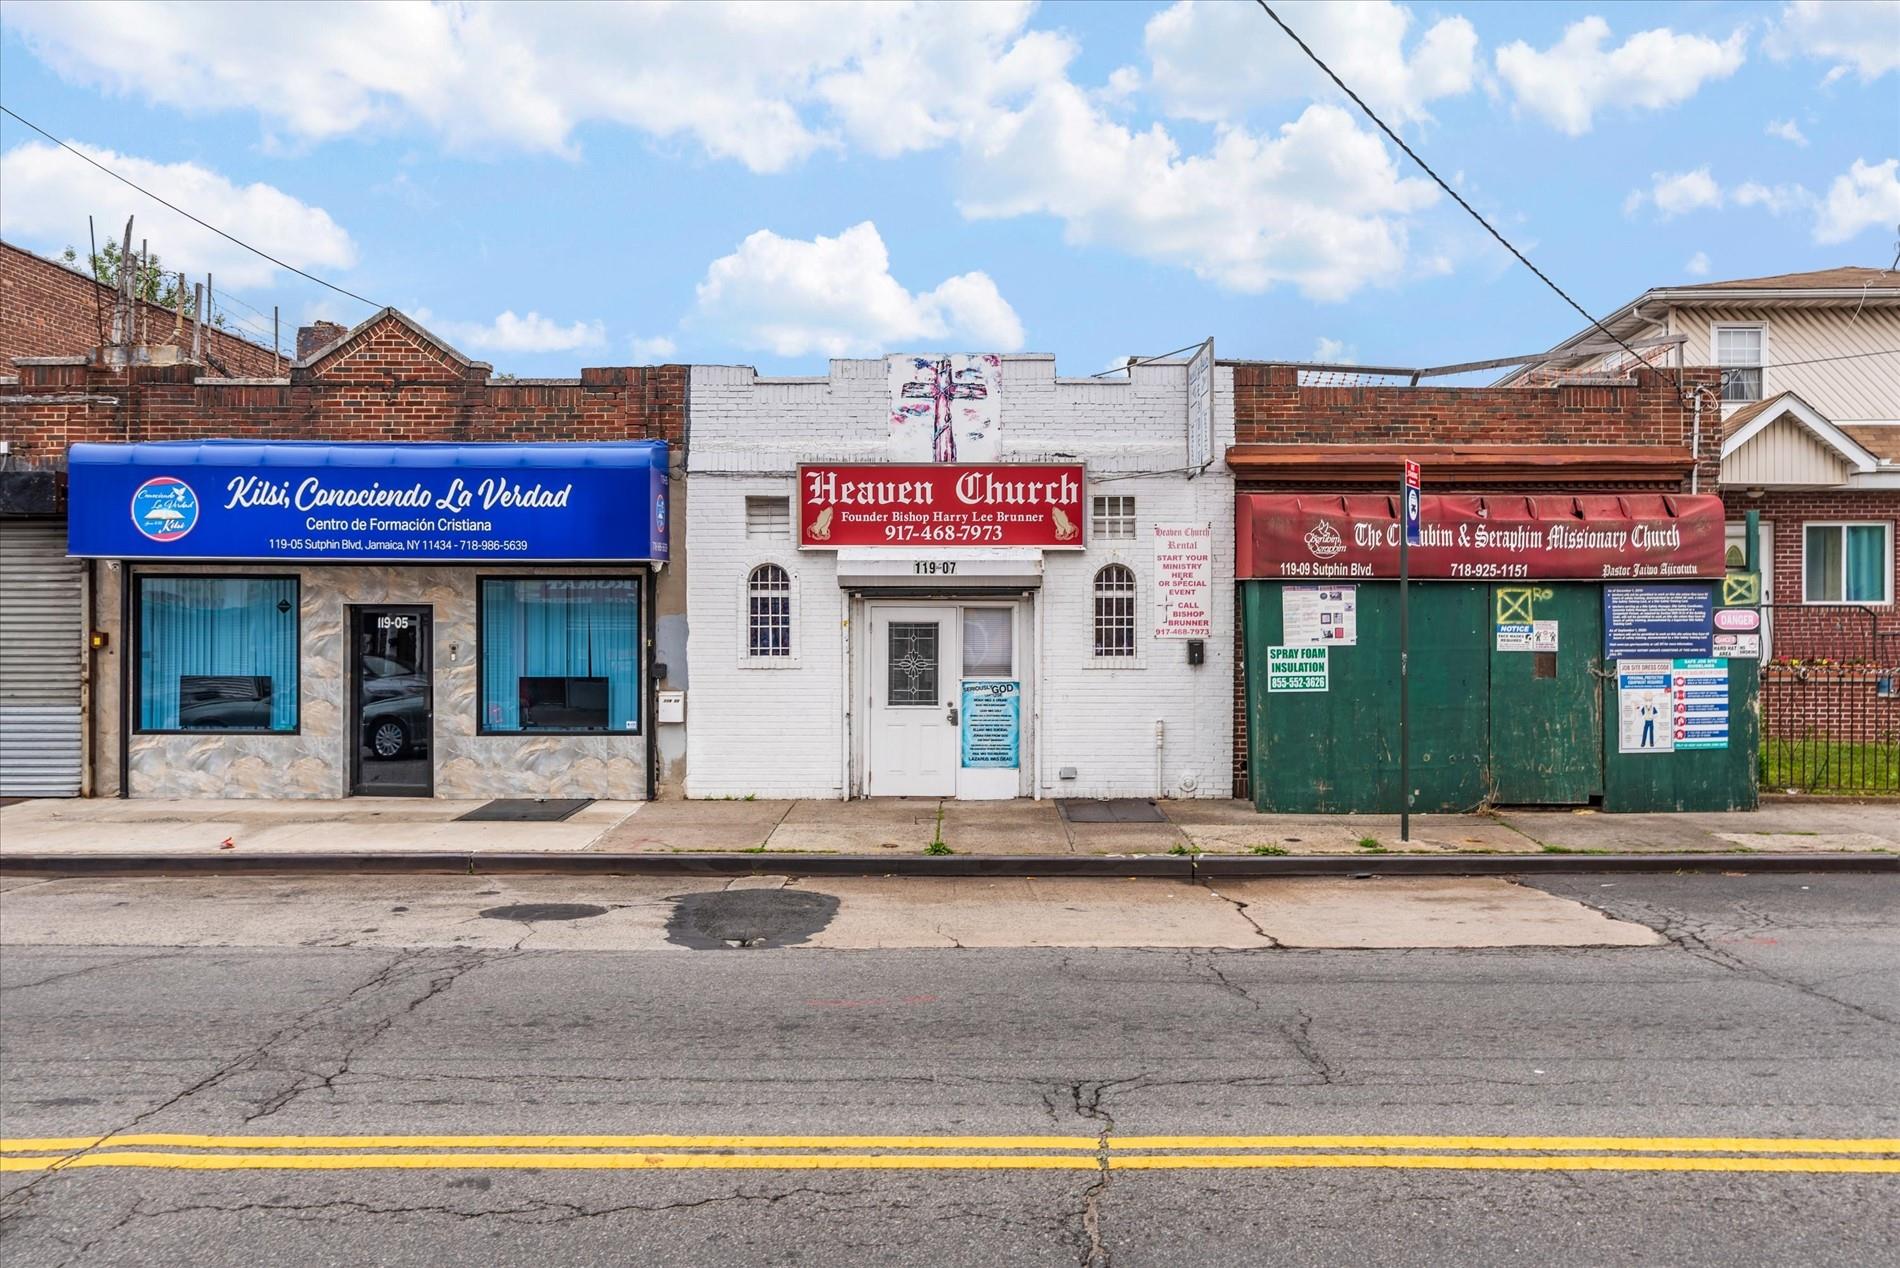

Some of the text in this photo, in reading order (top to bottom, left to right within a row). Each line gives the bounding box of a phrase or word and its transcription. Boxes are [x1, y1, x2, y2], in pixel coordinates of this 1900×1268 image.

[224, 475, 572, 513] Kilsi, Conociendo La Verdad
[806, 471, 1078, 504] Heaven Church
[306, 517, 492, 531] Centro de Formación Cristiana
[841, 511, 1044, 524] Founder Bishop Harry Lee Brunner
[884, 525, 1003, 541] 917-468-7973
[1354, 522, 1680, 552] The Cubim & Seraphim Missionary Church
[269, 539, 303, 549] 119-05
[305, 539, 340, 551] Sutphin
[365, 539, 405, 551] Jamaica,
[407, 540, 420, 550] NY
[423, 540, 451, 550] 11434
[460, 540, 528, 550] 718-986-5639
[915, 561, 956, 574] 119-07
[1280, 562, 1374, 576] 119-09 Sutphin Blvd.
[1450, 563, 1528, 577] 718-925-1151
[378, 616, 409, 629] 119-05
[1721, 614, 1755, 626] DANGER
[1270, 648, 1326, 659] SPRAY FOAM
[1271, 662, 1325, 672] INSULATION
[992, 684, 1014, 694] GOD
